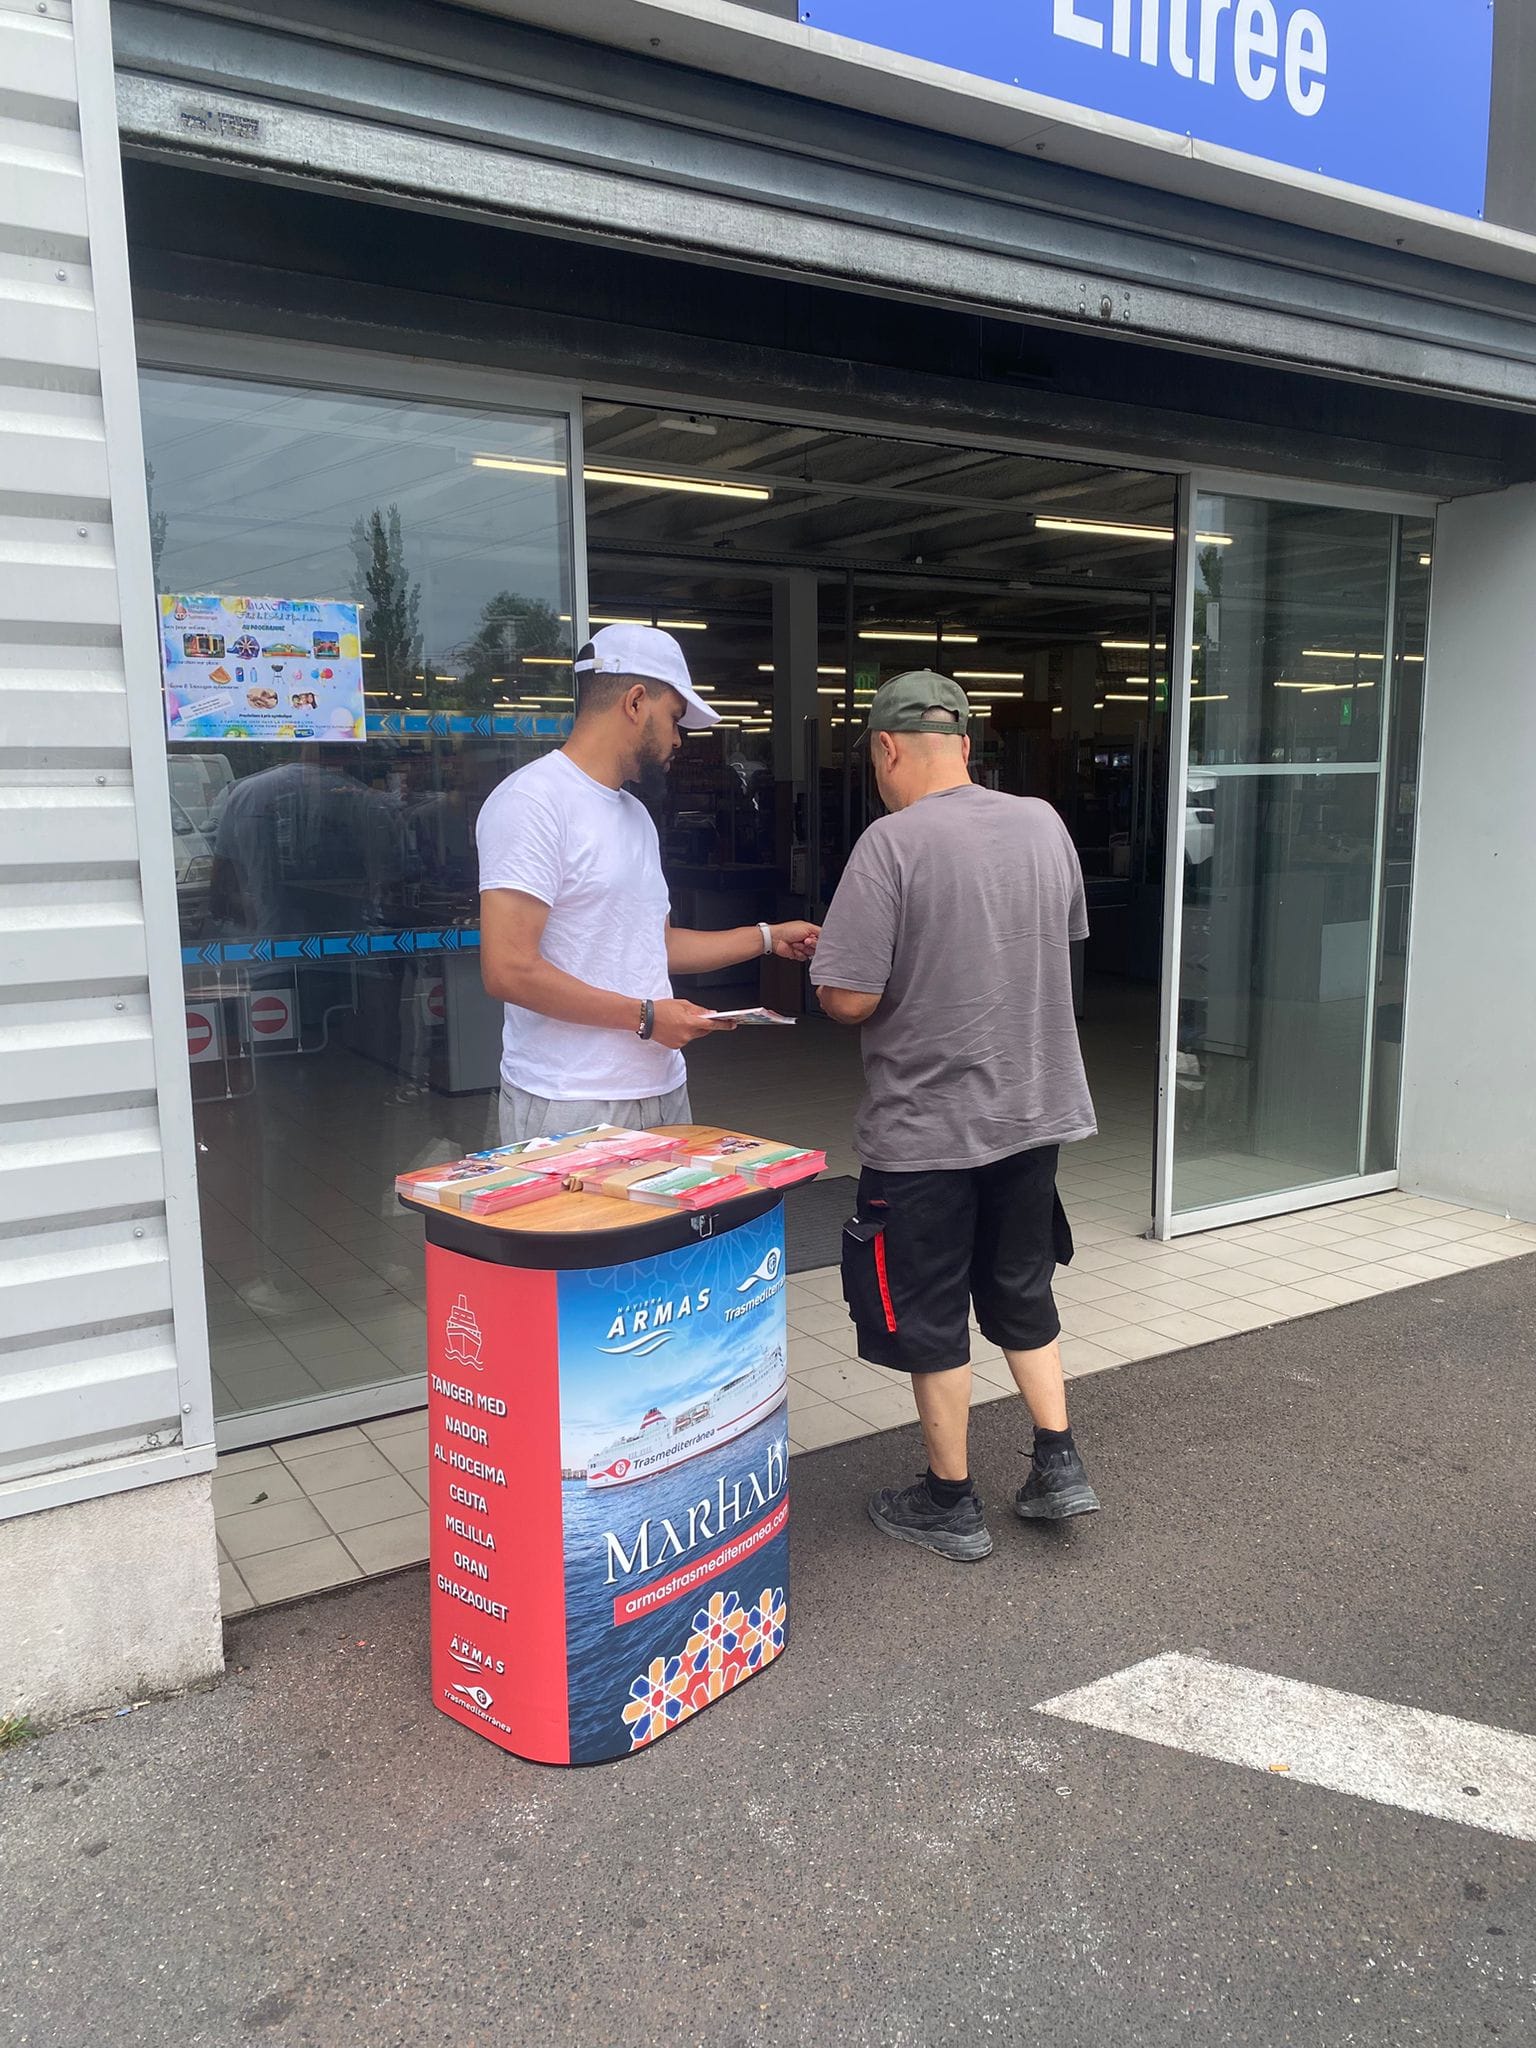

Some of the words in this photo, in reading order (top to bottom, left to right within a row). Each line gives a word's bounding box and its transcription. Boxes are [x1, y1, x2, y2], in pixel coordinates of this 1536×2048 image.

[606, 1287, 711, 1339] ARMAS
[431, 1373, 474, 1406] TANGER
[477, 1393, 507, 1416] MED
[445, 1414, 488, 1446] NADOR
[434, 1442, 448, 1463] AL
[449, 1449, 506, 1486] HOCEIMA
[449, 1483, 488, 1513] CEUTA
[445, 1513, 495, 1550] MELILLA
[453, 1551, 488, 1579] ORAN
[437, 1574, 509, 1621] GHAZAOUET
[450, 1637, 505, 1674] ARMAS
